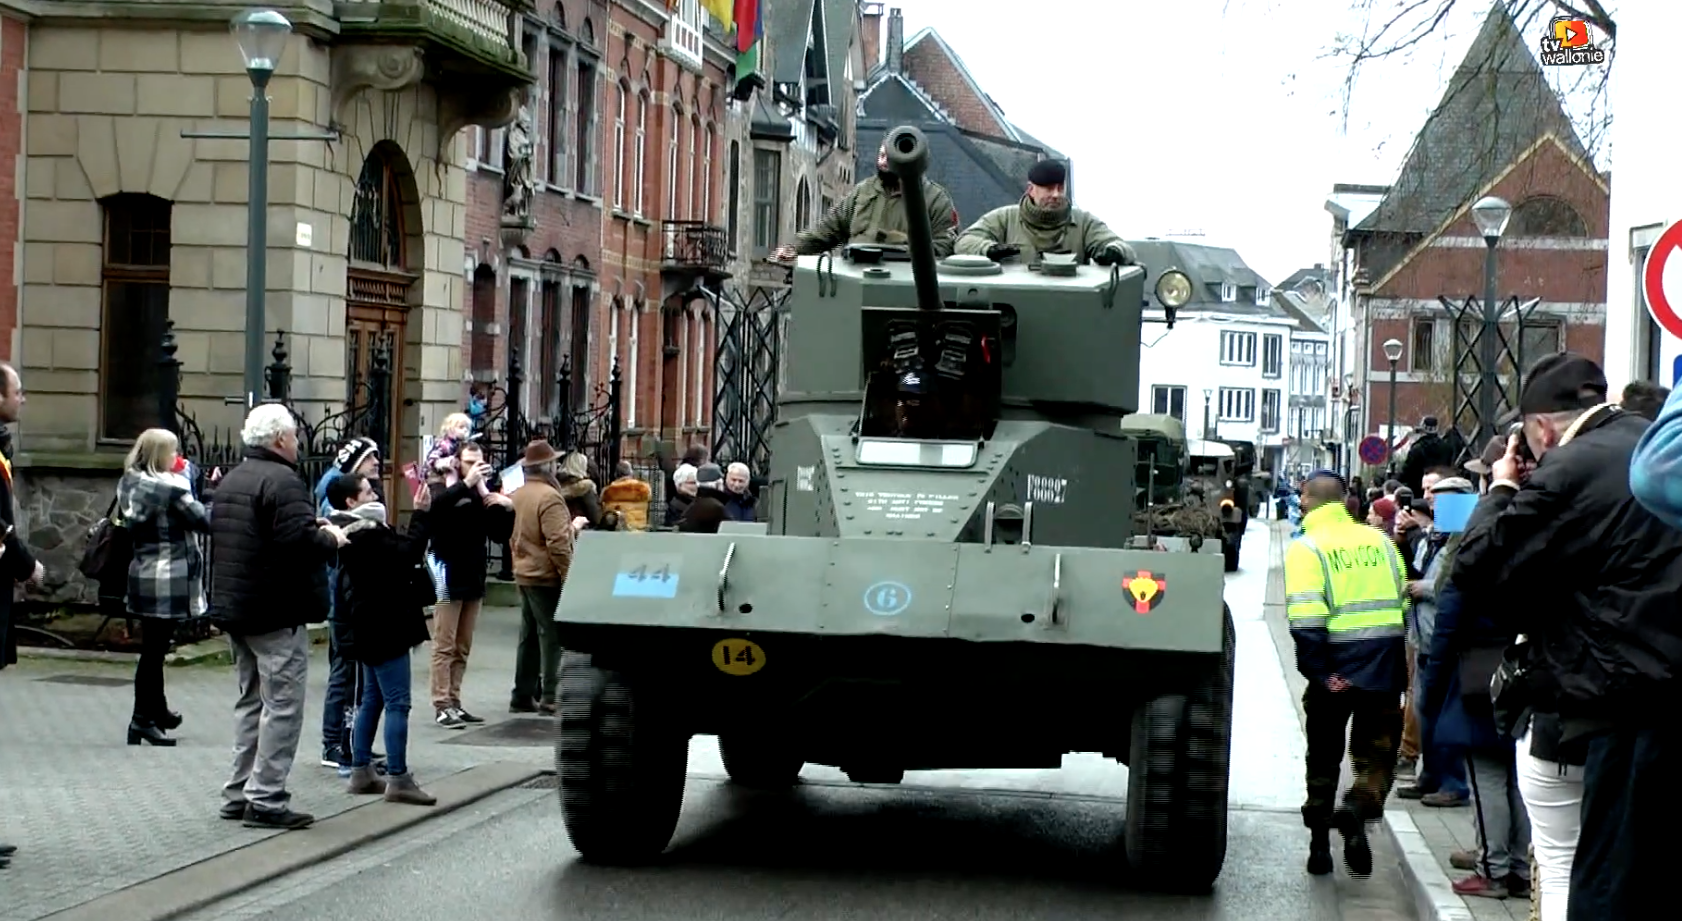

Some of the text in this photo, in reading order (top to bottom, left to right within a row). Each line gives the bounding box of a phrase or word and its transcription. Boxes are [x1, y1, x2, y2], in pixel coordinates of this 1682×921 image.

[628, 564, 671, 583] 44
[876, 588, 898, 609] 6
[722, 645, 756, 666] 14
